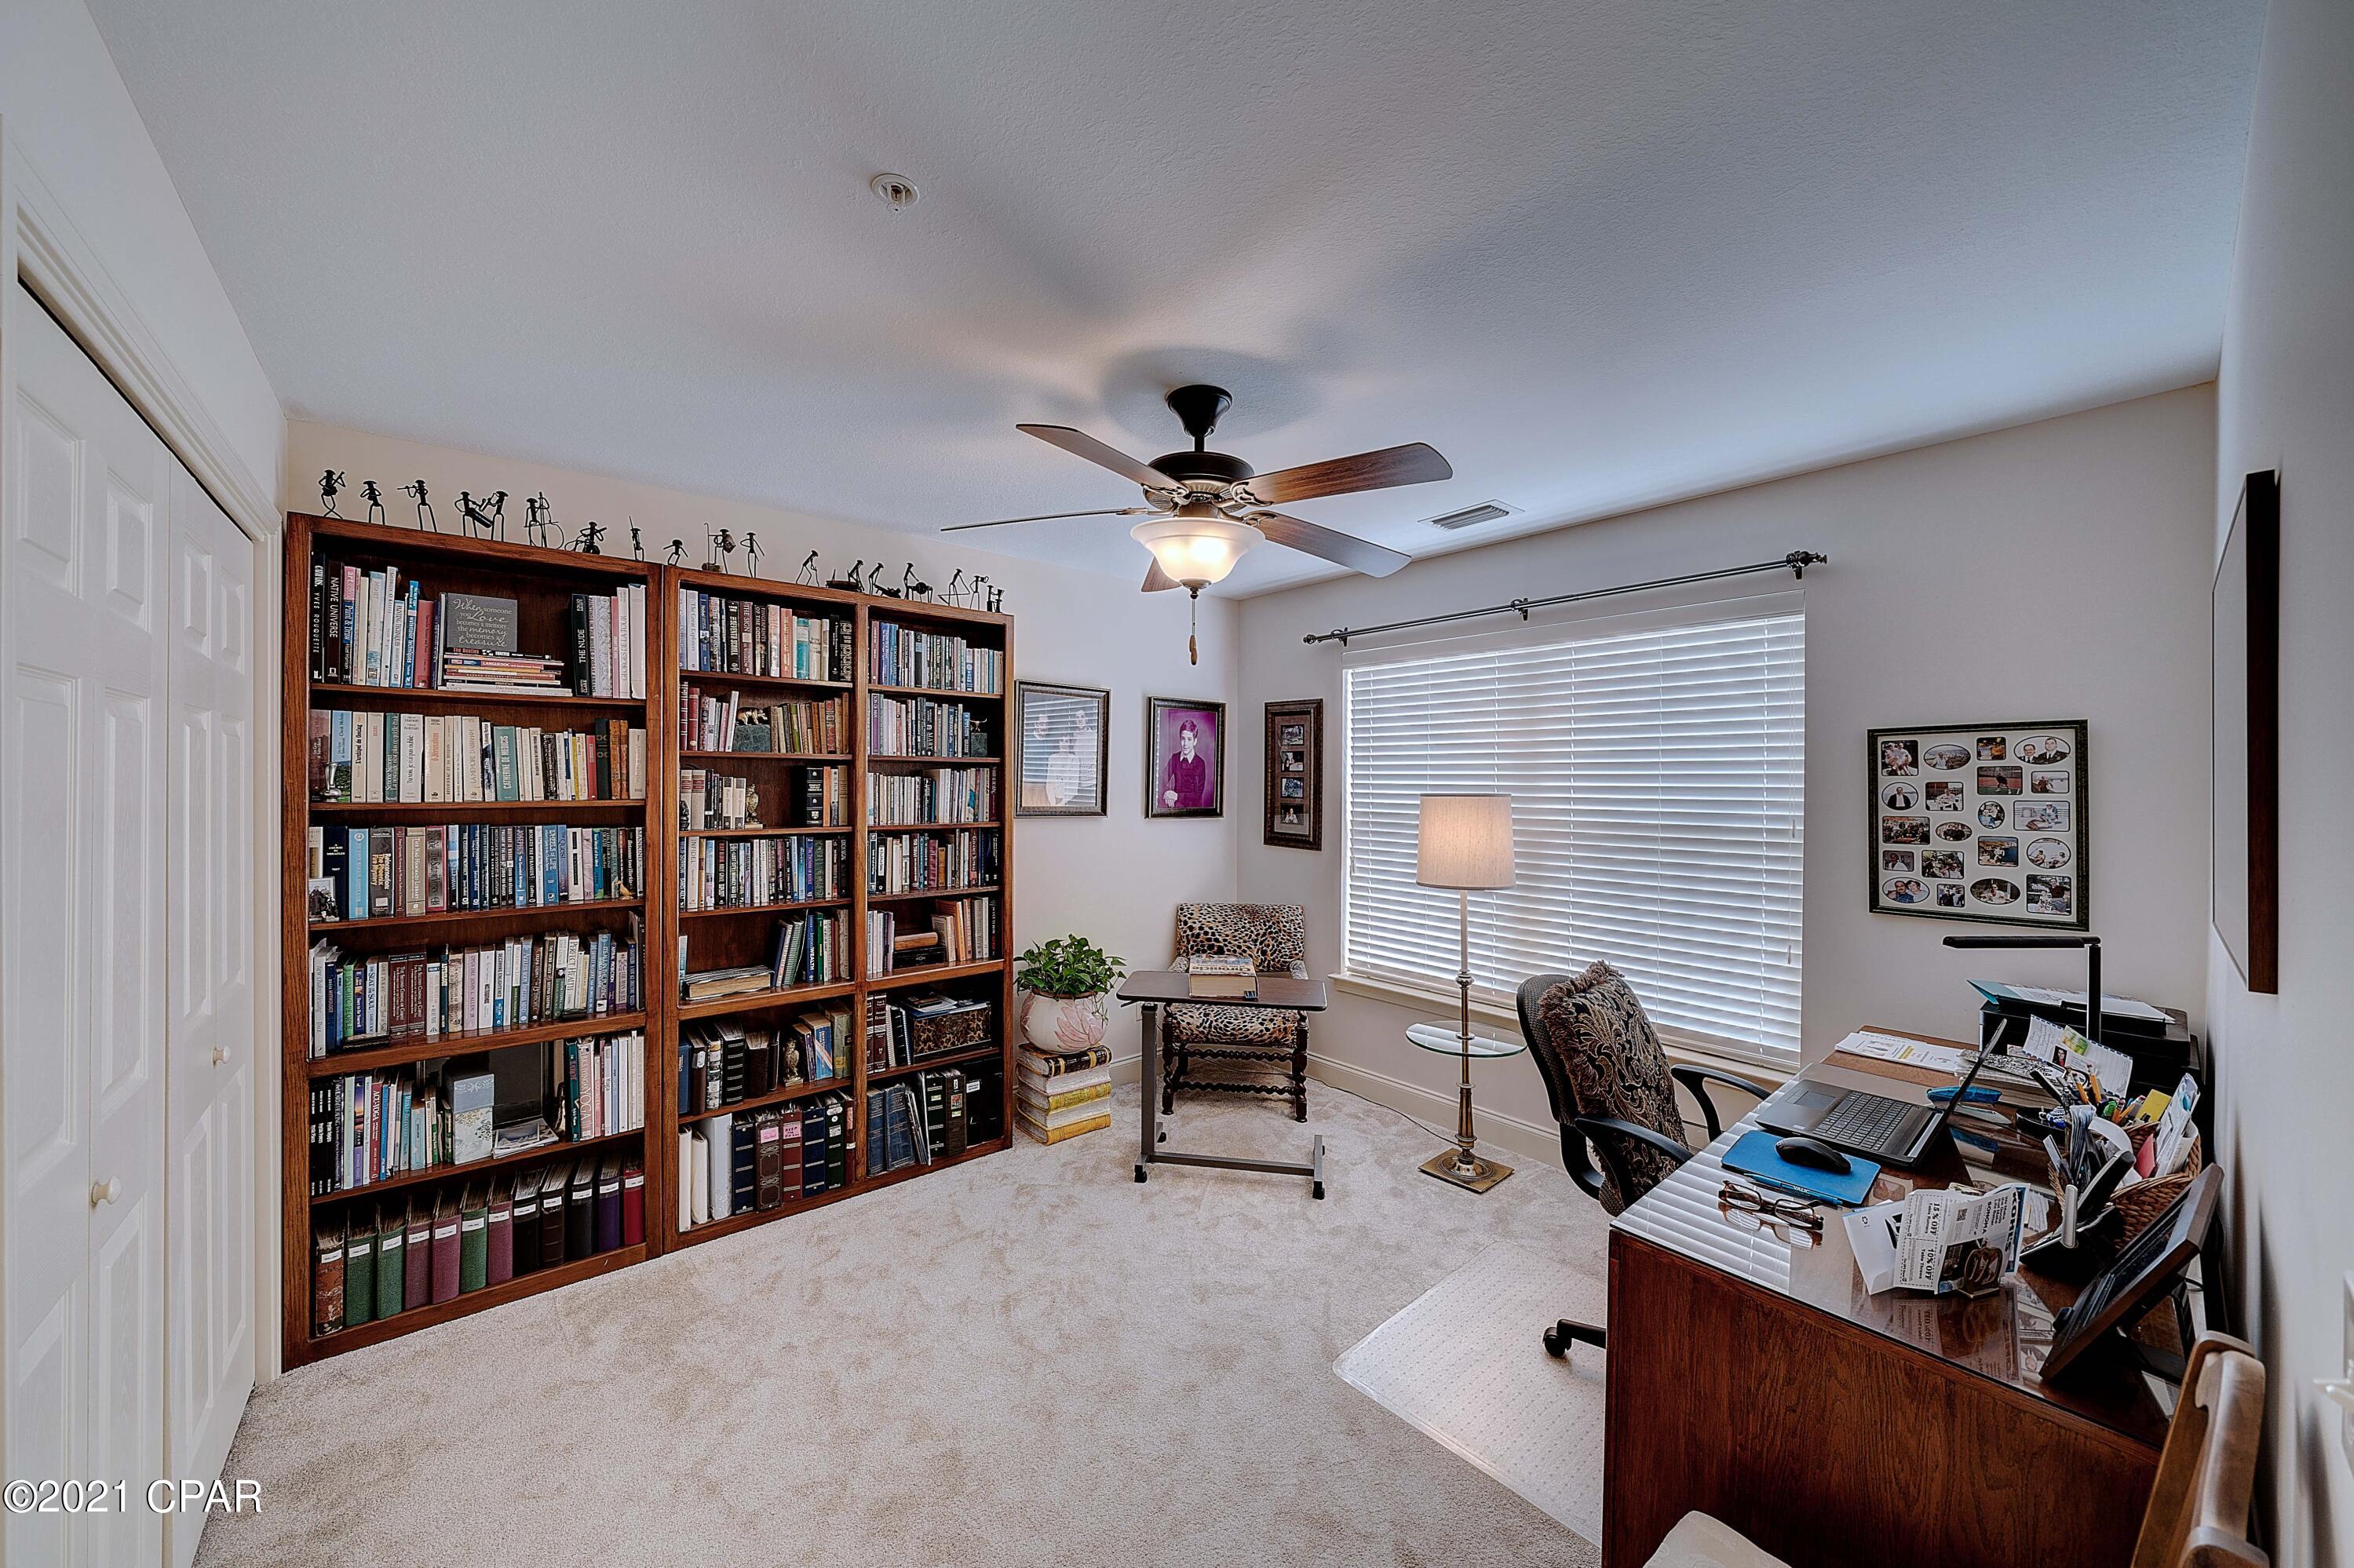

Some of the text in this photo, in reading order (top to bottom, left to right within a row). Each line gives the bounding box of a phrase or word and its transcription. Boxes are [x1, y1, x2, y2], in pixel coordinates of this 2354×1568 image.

[329, 577, 339, 638] NATIVE UNIVERSE
[454, 599, 483, 611] When
[345, 605, 353, 620] Paint
[467, 611, 509, 623] Love
[469, 627, 506, 638] memory
[621, 633, 627, 641] LA
[458, 635, 506, 647] treasure
[621, 642, 627, 651] DE
[502, 764, 512, 789] CATHERINE
[372, 1091, 381, 1121] ACU-YOGA
[580, 1088, 592, 1121] YOGA
[2003, 1195, 2009, 1205] We
[1932, 1203, 1940, 1212] 15
[1982, 1201, 1992, 1234] SONOMA
[2005, 1191, 2017, 1253] KOHL'S
[1929, 1221, 1938, 1235] OFF
